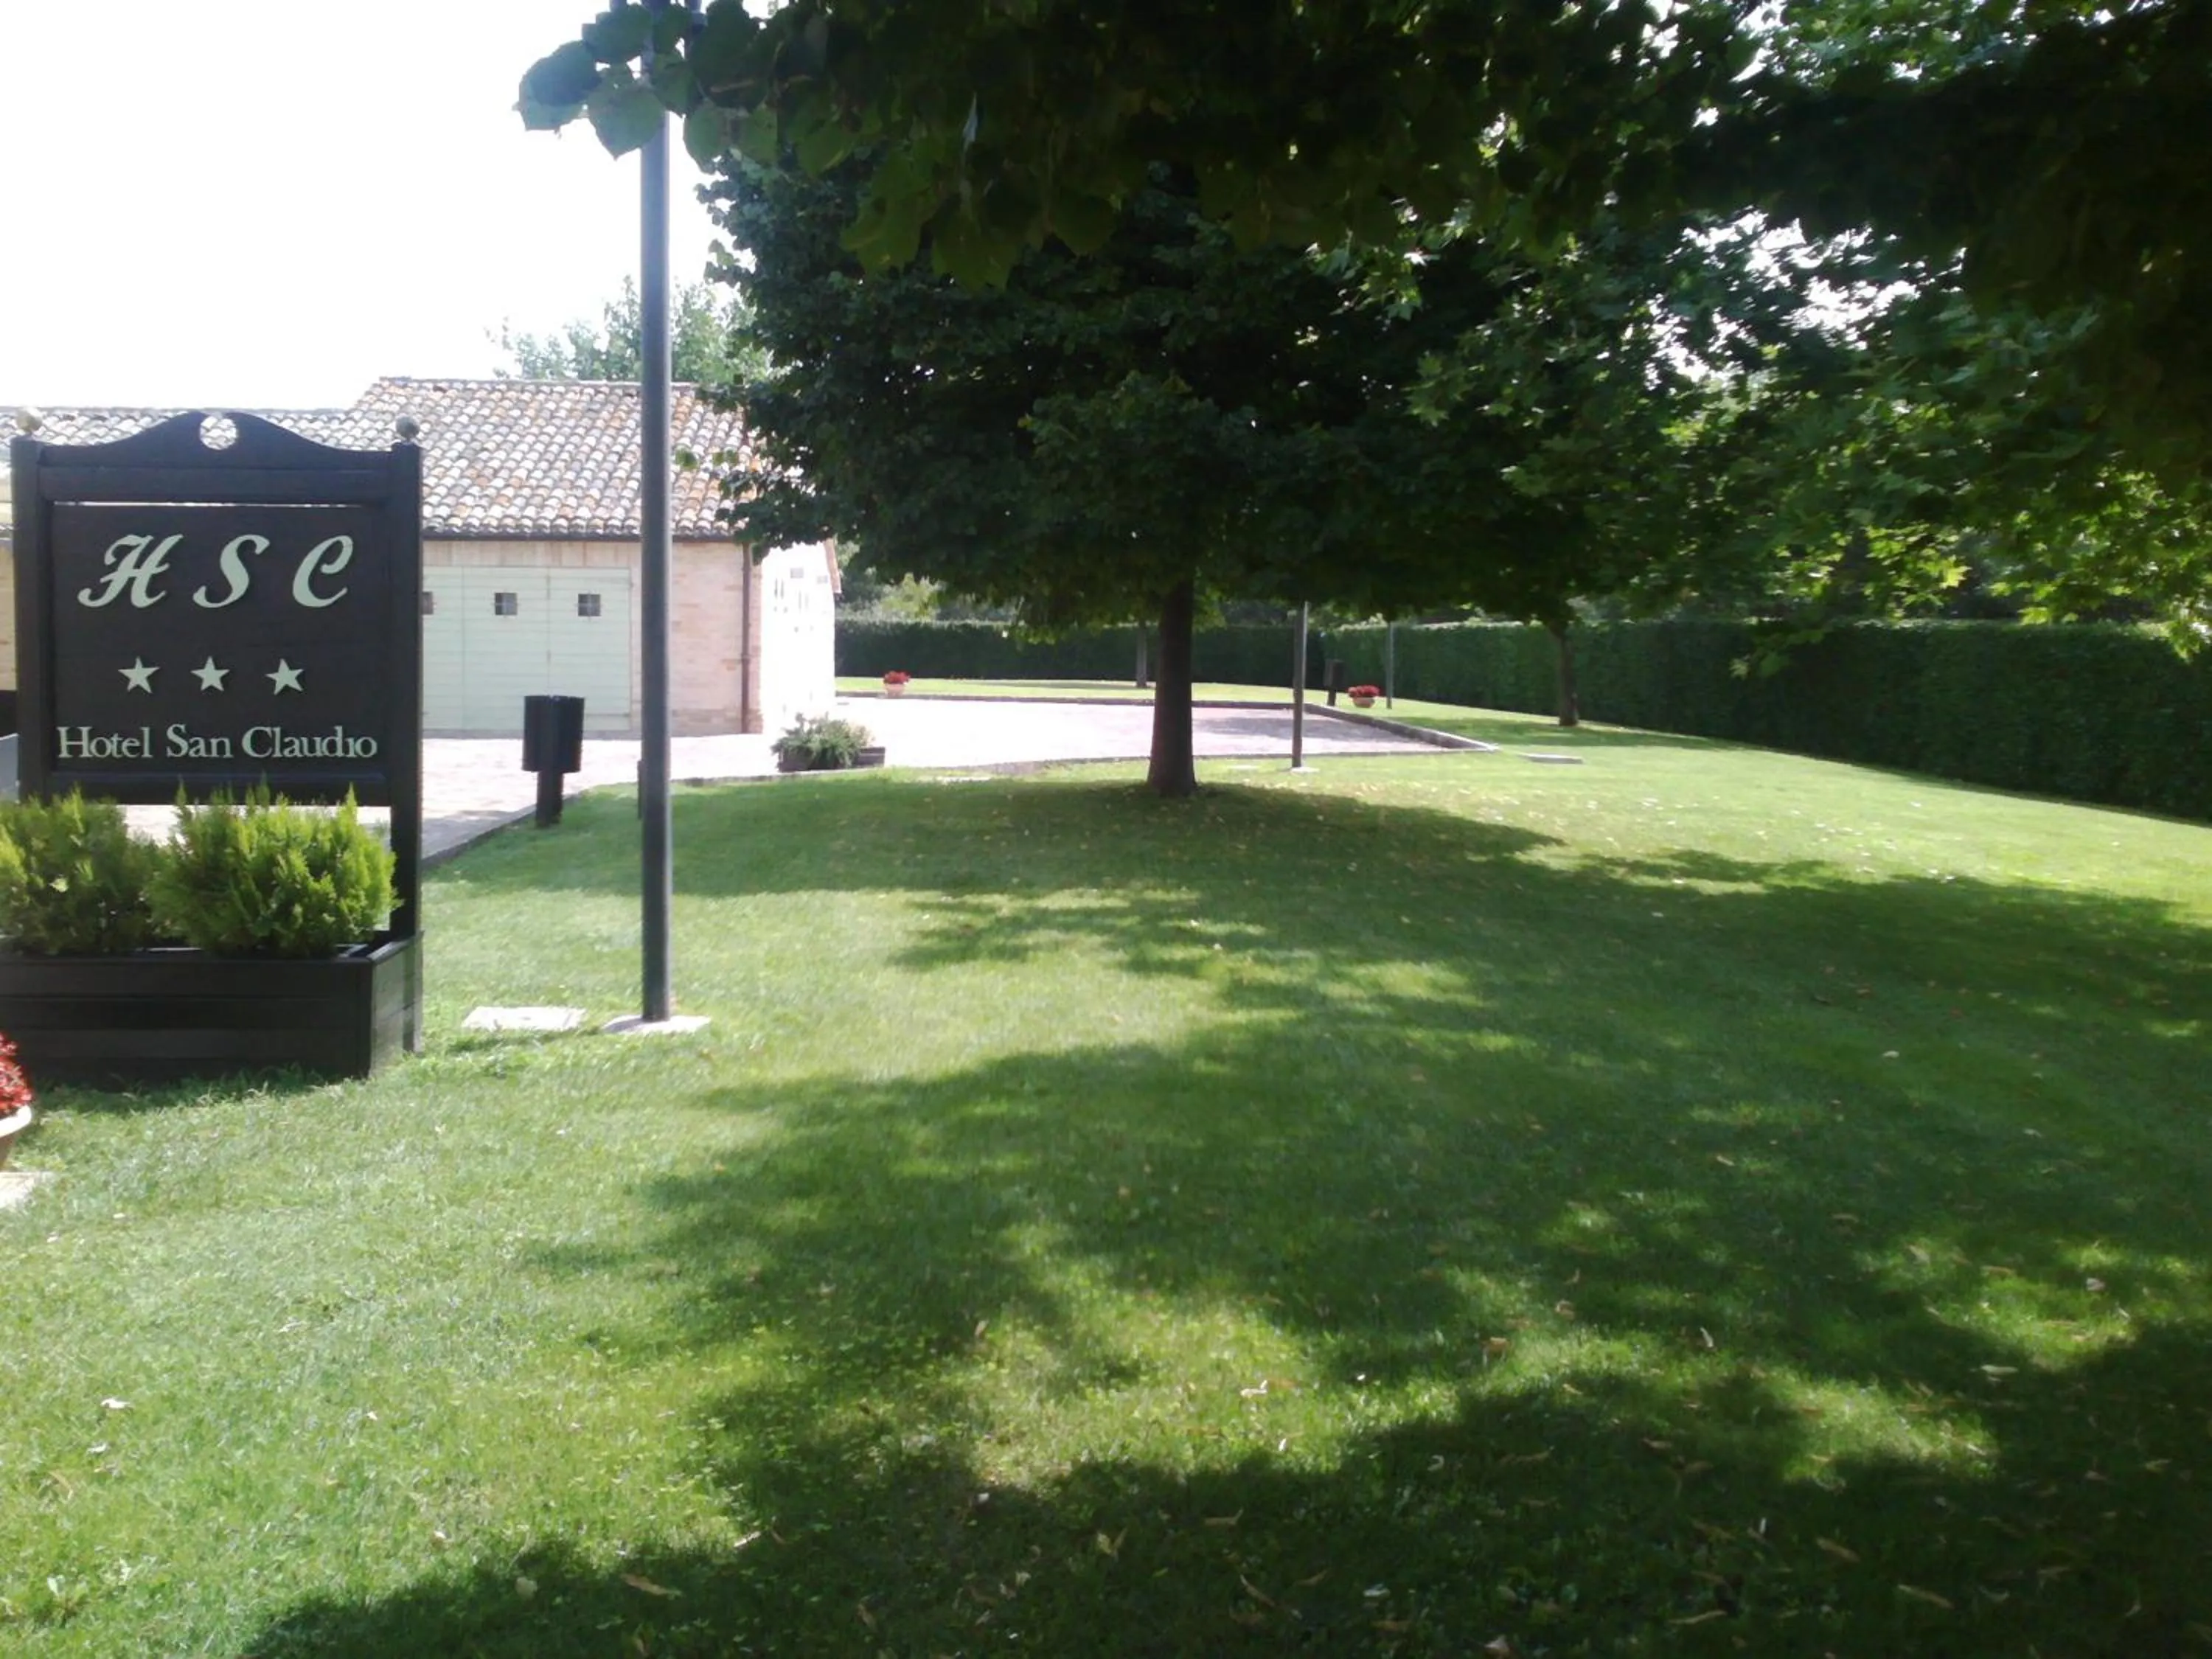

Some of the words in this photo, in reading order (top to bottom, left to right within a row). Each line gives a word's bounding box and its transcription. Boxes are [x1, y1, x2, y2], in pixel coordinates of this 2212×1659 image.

[57, 726, 153, 758] Hotel
[166, 723, 233, 758] San
[241, 726, 378, 758] Claudio
